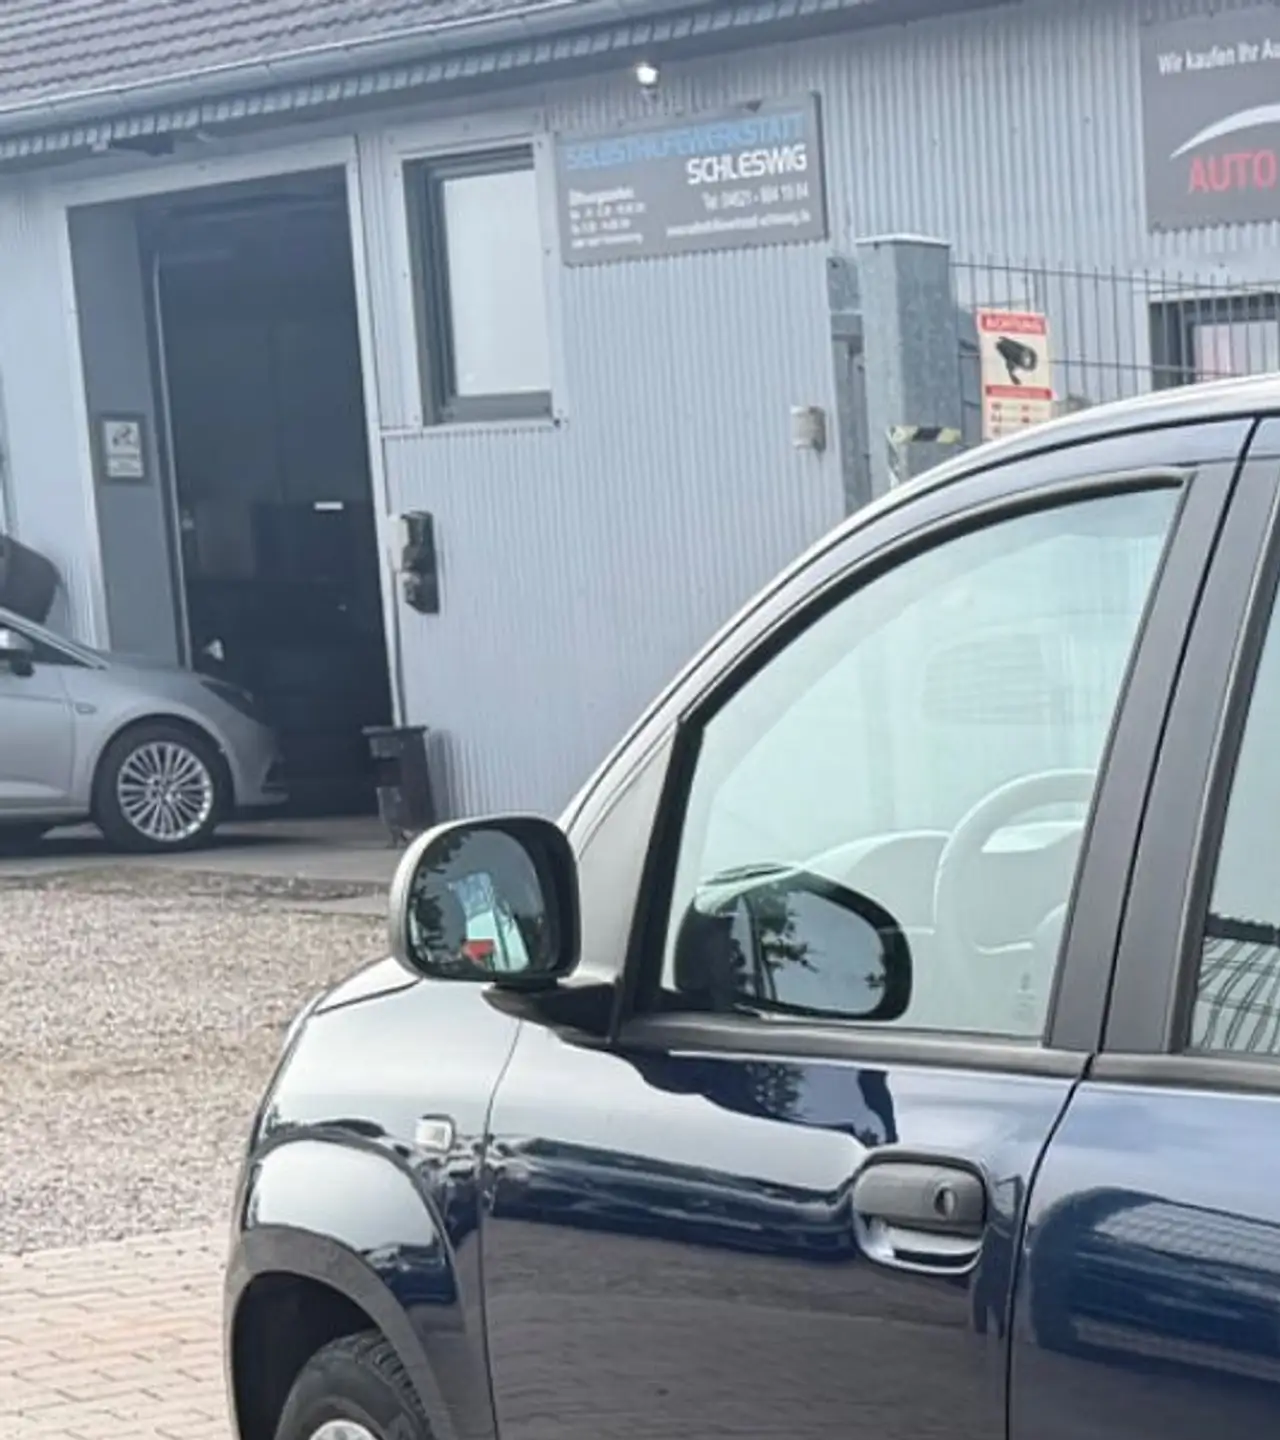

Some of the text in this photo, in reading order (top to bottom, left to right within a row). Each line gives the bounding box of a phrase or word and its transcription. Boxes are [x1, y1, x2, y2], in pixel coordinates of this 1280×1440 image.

[1157, 53, 1182, 76] Wir
[1185, 45, 1235, 71] kaufen
[1238, 42, 1259, 64] Ihr
[685, 144, 808, 185] SCHLESWIG
[1188, 149, 1278, 194] AUTO
